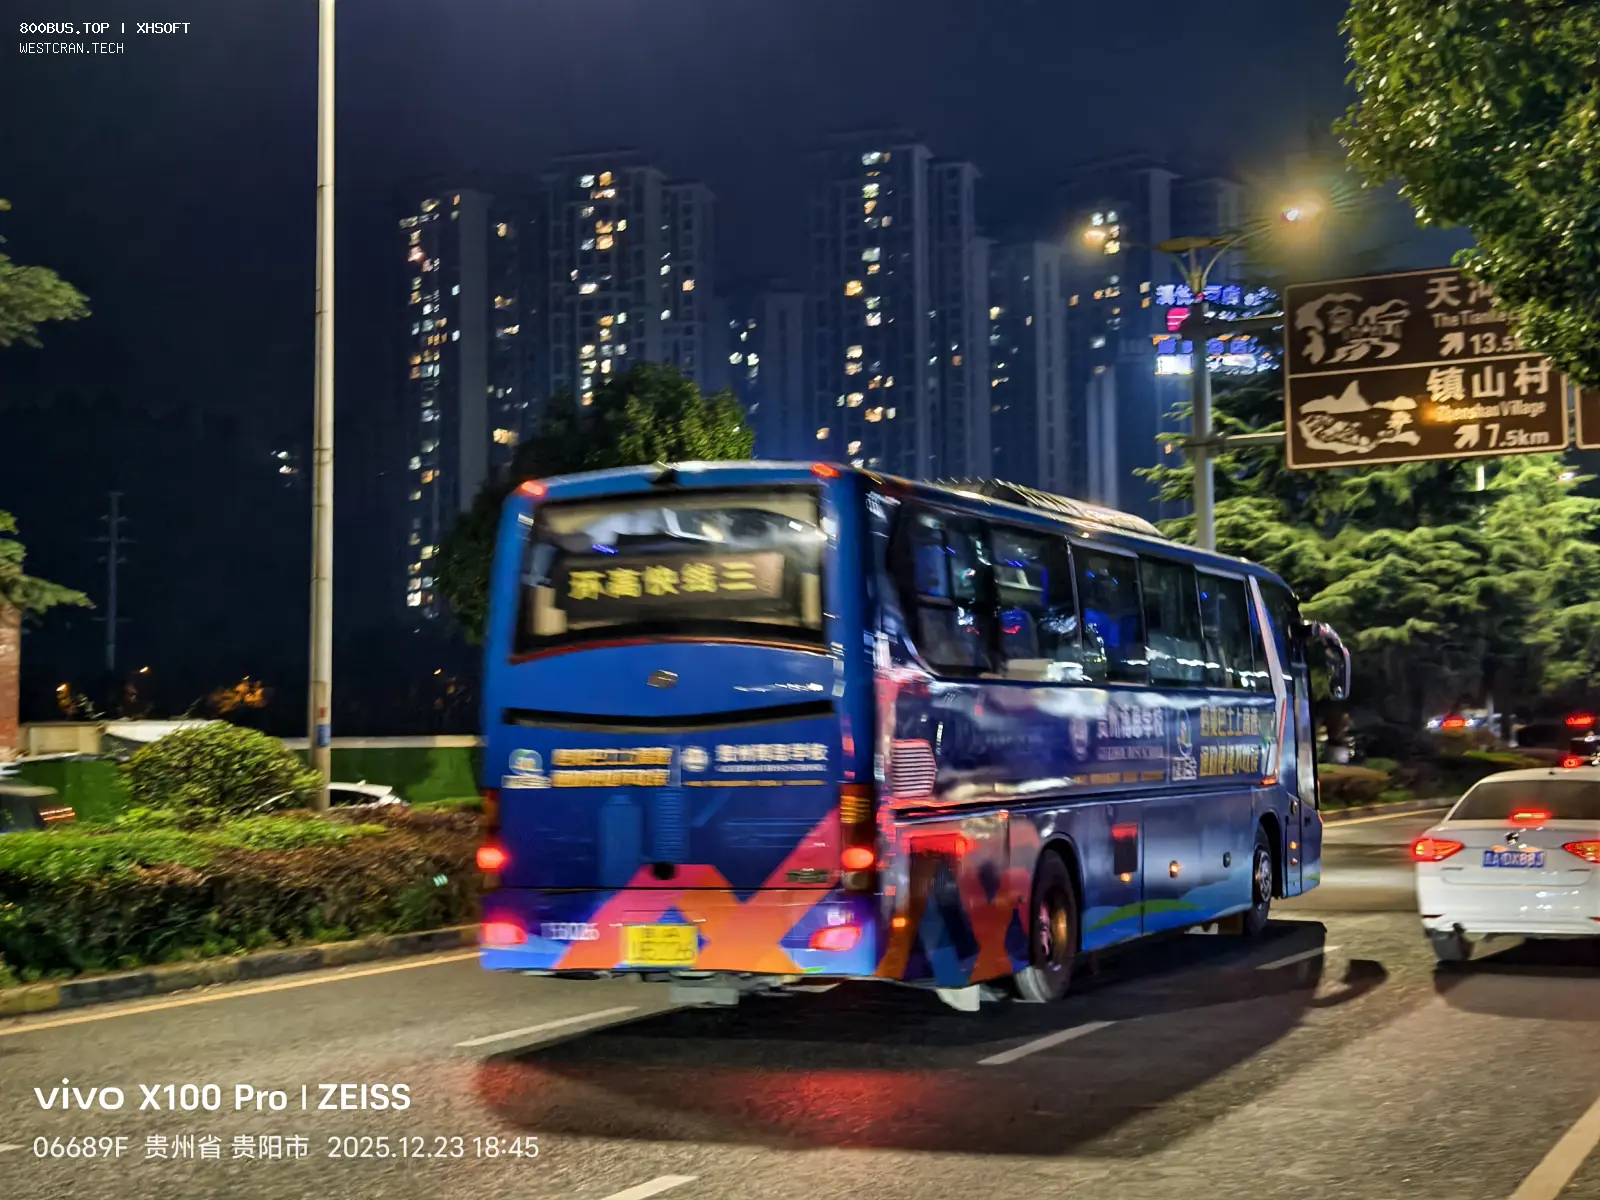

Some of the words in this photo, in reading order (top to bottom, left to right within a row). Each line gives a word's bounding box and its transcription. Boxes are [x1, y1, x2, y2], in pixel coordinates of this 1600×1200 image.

[1469, 331, 1526, 354] 13.5
[1426, 360, 1551, 403] 镇山村
[1500, 399, 1547, 418] Village
[1484, 422, 1550, 448] 7.5km
